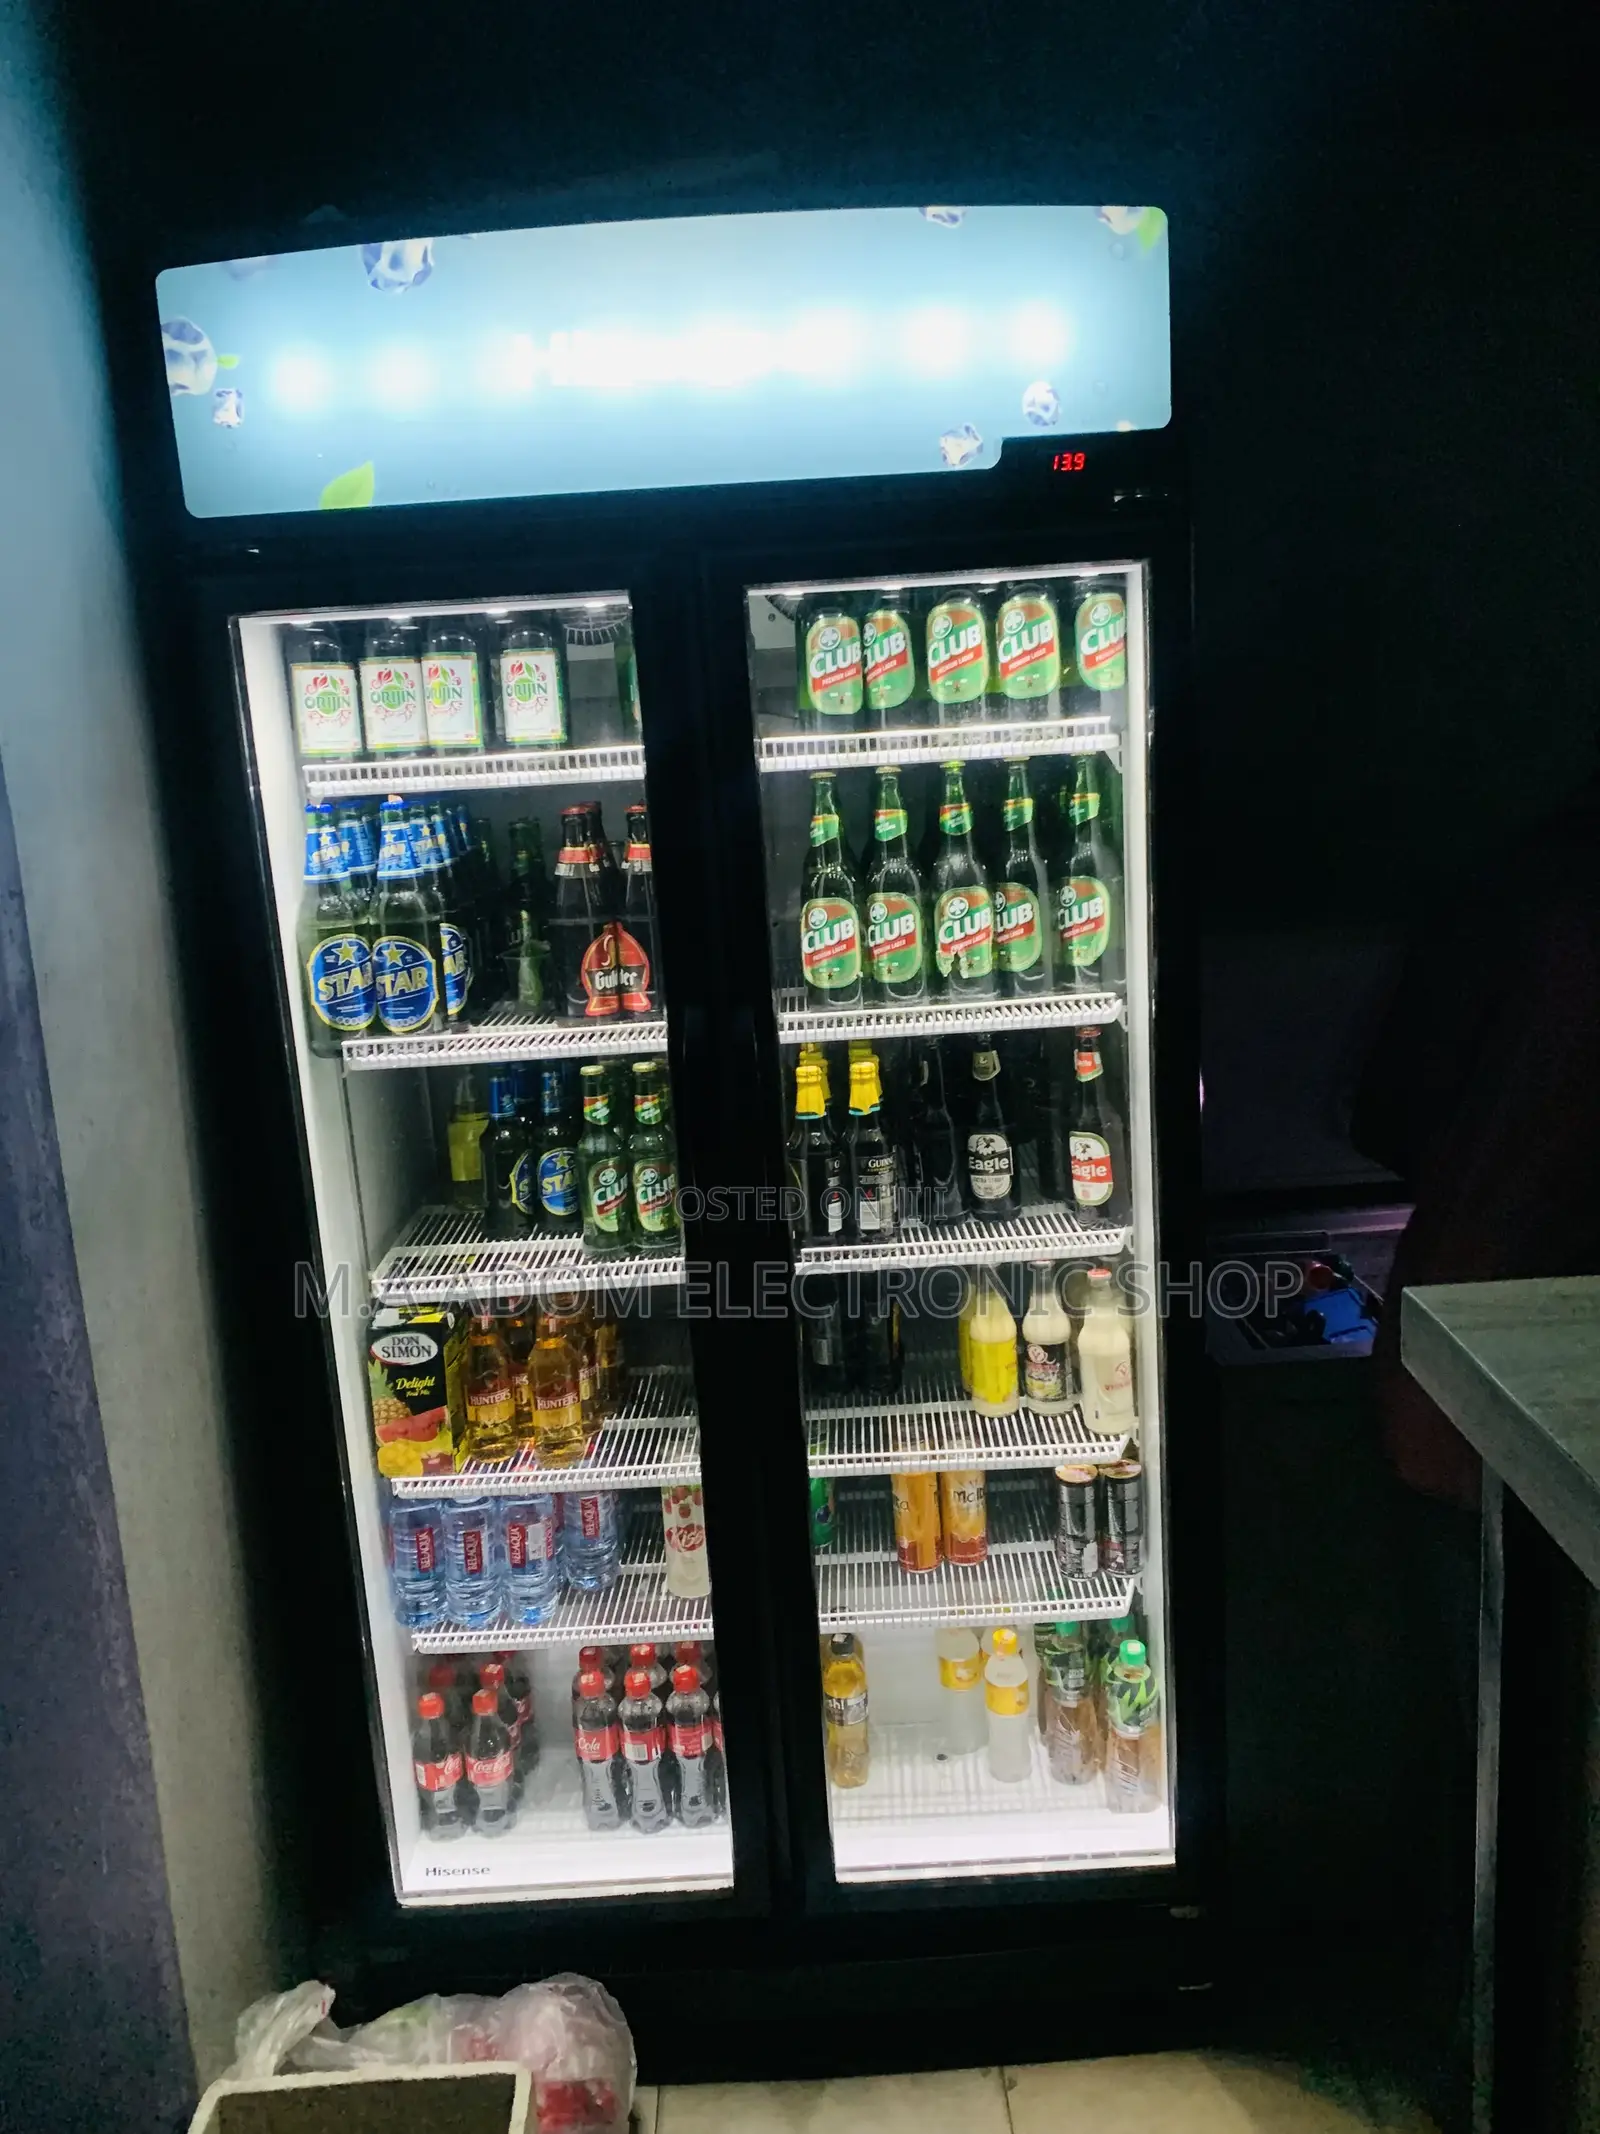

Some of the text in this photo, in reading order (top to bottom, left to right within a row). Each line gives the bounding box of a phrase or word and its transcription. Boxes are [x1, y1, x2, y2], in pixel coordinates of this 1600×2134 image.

[929, 624, 982, 668] CLUB
[999, 620, 1054, 663] CLUB
[809, 640, 861, 678] CLUB
[370, 688, 416, 706] ORIJIN
[506, 681, 548, 698] ORIJIN
[304, 695, 351, 712] ORIJIN
[997, 902, 1033, 933] LUB
[1058, 897, 1104, 930] CLUB
[802, 918, 855, 953] CLUB
[868, 914, 915, 947] CLUB
[939, 907, 992, 944] CLUB
[969, 1157, 1009, 1173] Eagle
[542, 1171, 574, 1193] STA
[382, 1345, 432, 1358] SIMON
[392, 1336, 420, 1345] DON
[396, 1376, 435, 1390] Delight
[426, 1867, 490, 1876] Hisense
